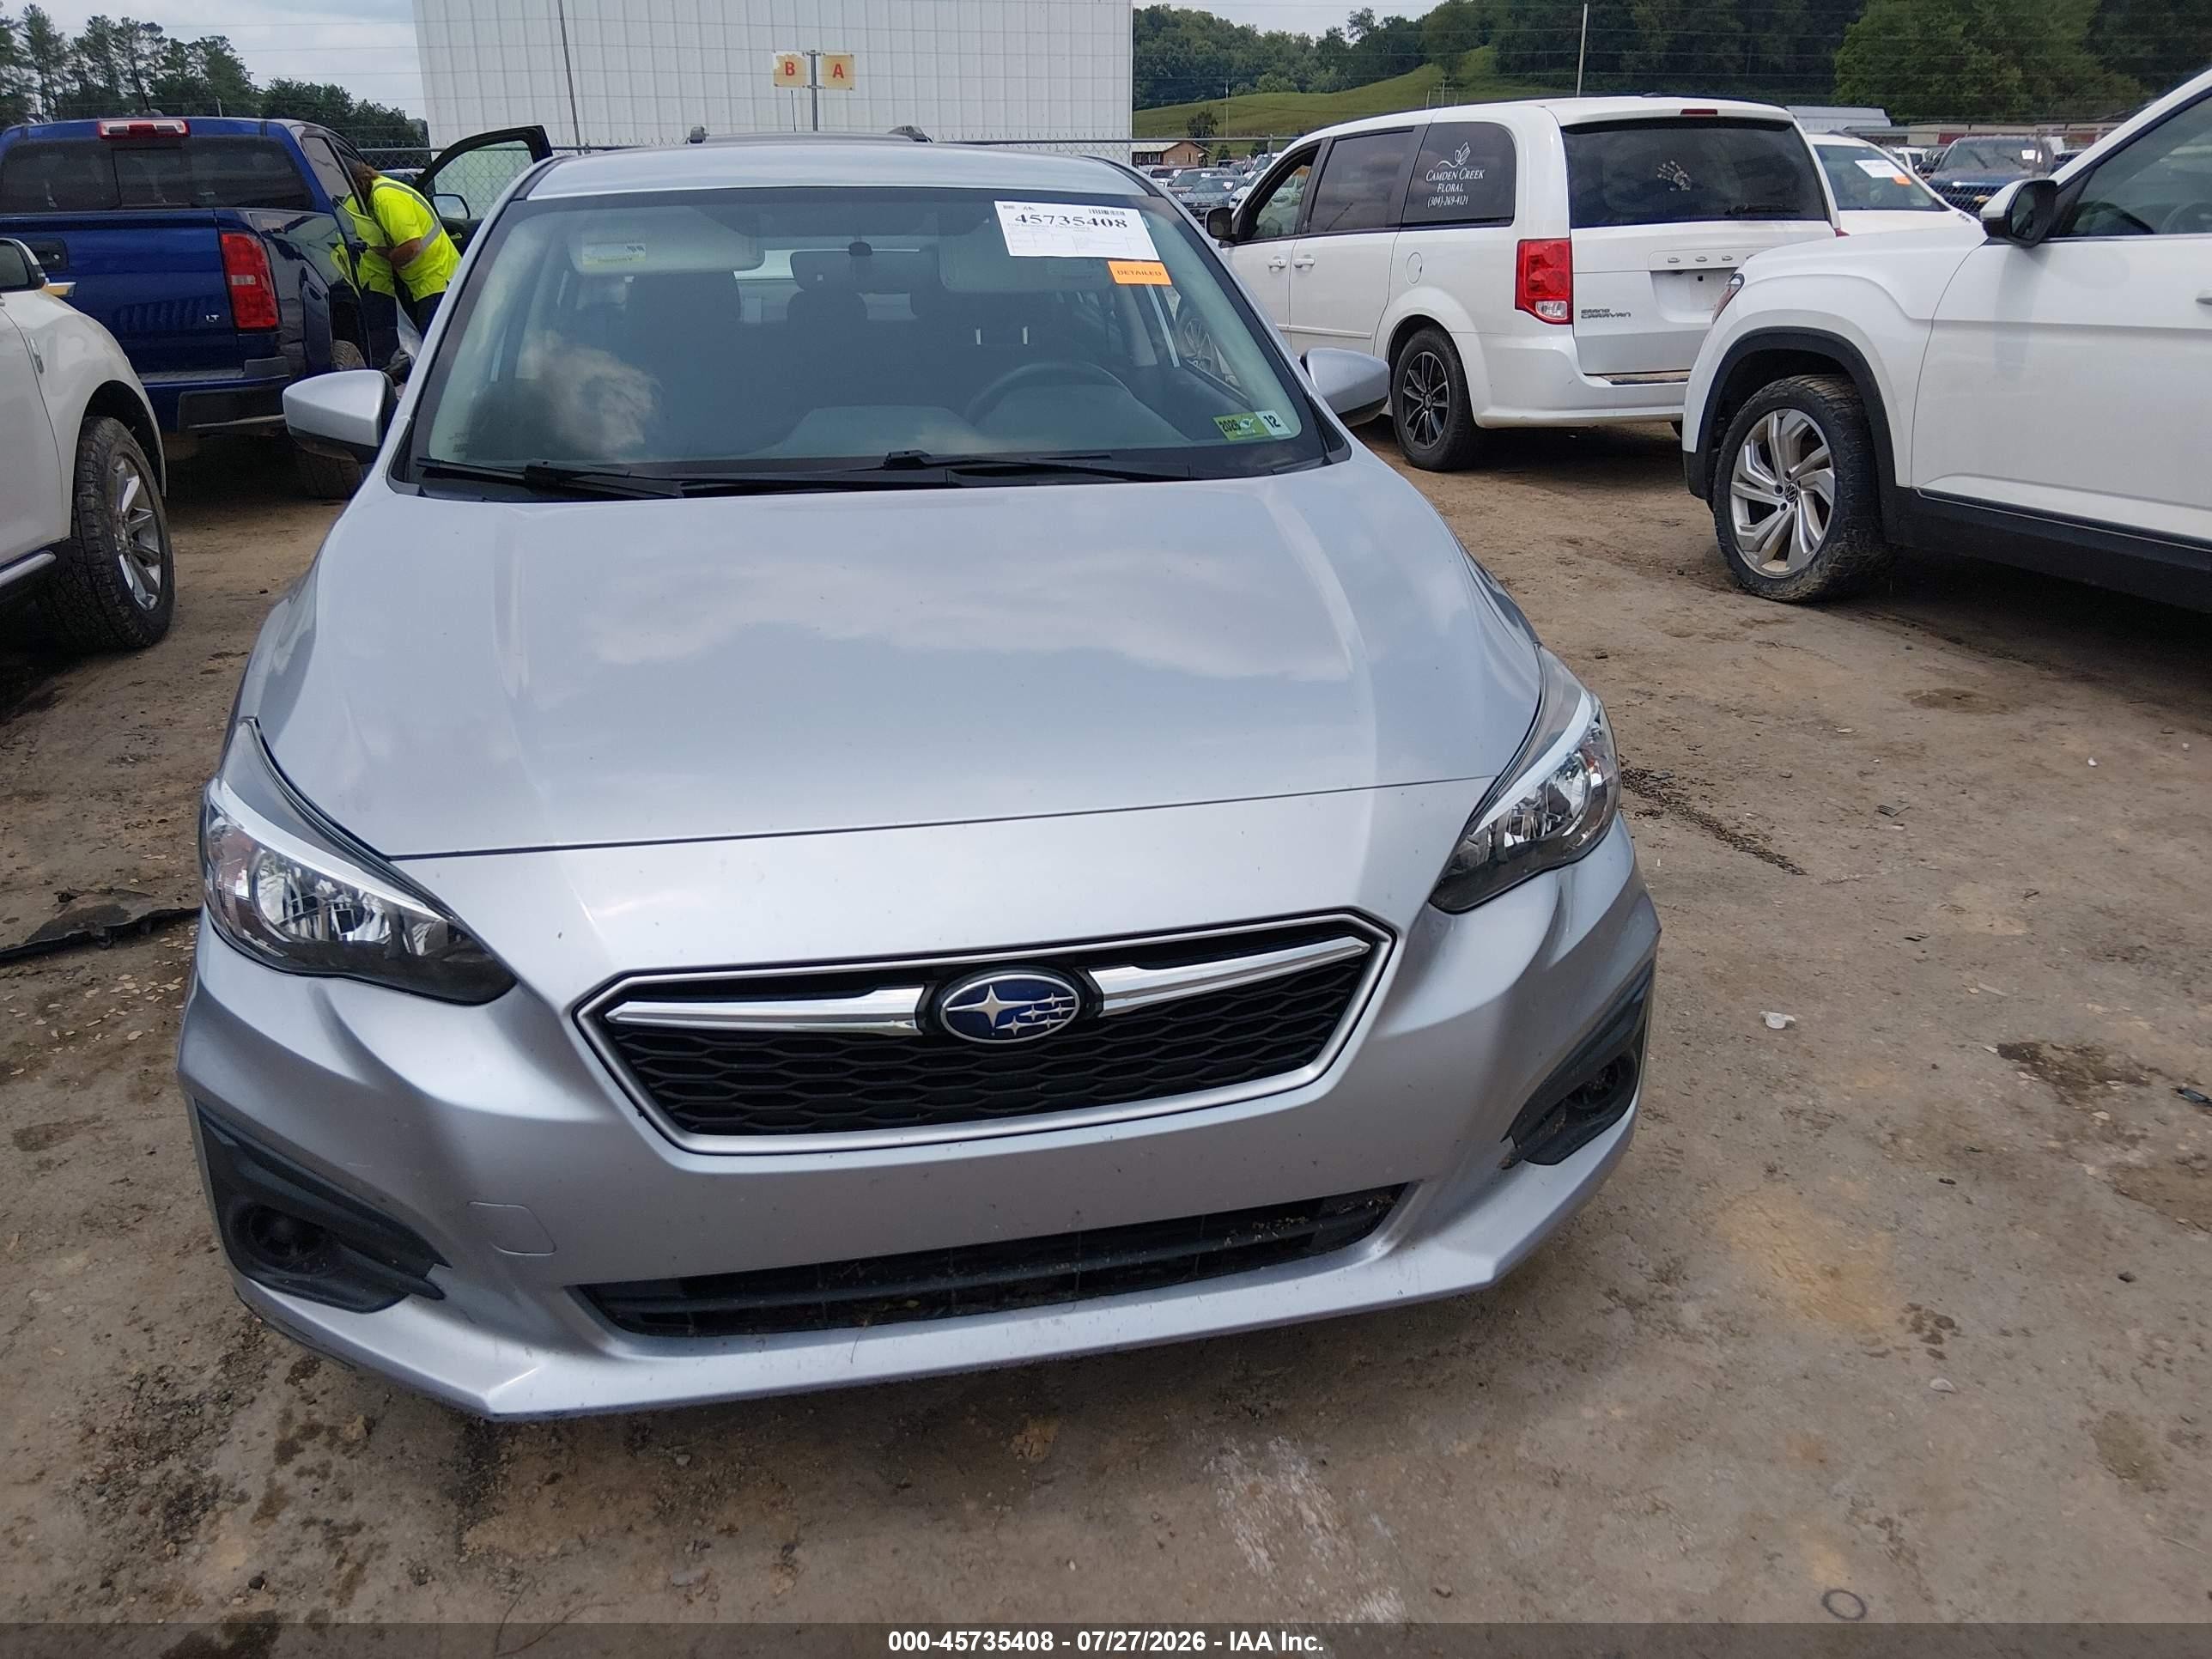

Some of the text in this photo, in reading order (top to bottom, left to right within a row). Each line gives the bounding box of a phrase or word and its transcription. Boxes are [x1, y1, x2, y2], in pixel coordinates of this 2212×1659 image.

[785, 61, 795, 76] B
[832, 63, 844, 79] A
[1425, 167, 1486, 182] CAMDEN CREEK
[1437, 183, 1464, 193] FLORAL
[1015, 214, 1127, 228] 45735408
[205, 314, 220, 323] LT
[1263, 415, 1281, 428] 12
